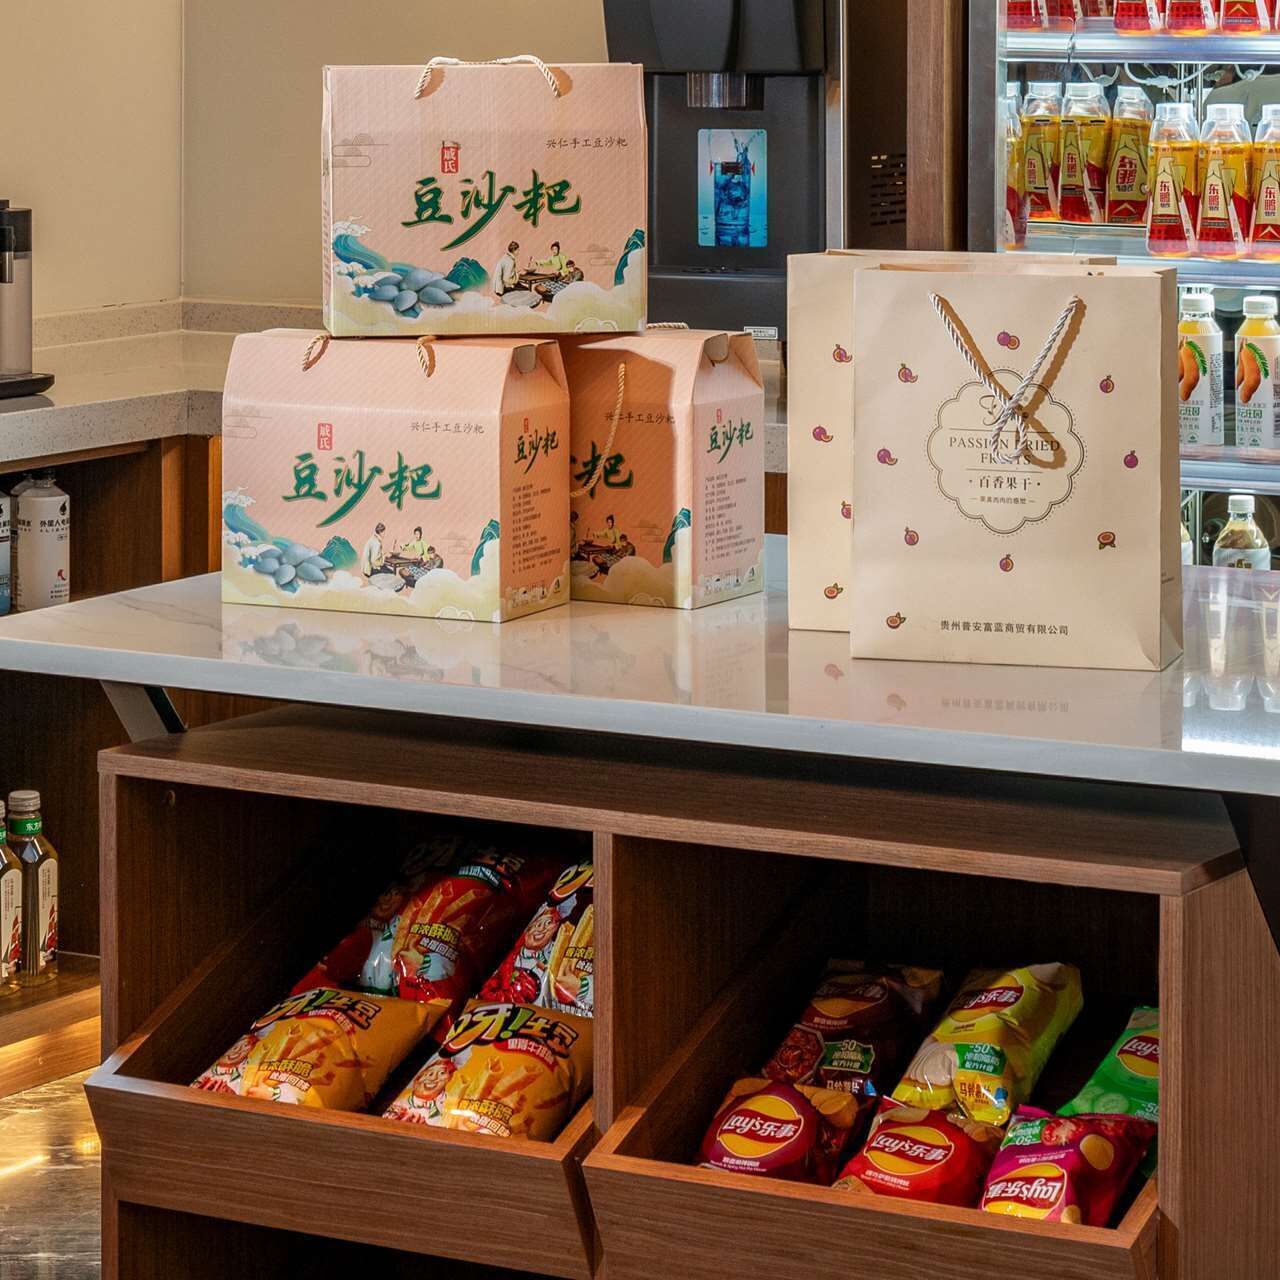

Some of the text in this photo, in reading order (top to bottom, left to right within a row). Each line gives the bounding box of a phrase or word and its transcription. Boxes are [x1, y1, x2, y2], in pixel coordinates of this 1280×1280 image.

[401, 169, 582, 252] 豆沙粑
[514, 427, 560, 475] 豆沙粑
[706, 418, 754, 464] 豆沙粑
[949, 436, 1009, 449] PASSIN
[282, 450, 442, 528] 豆沙粑
[979, 476, 1032, 491] 百香果干
